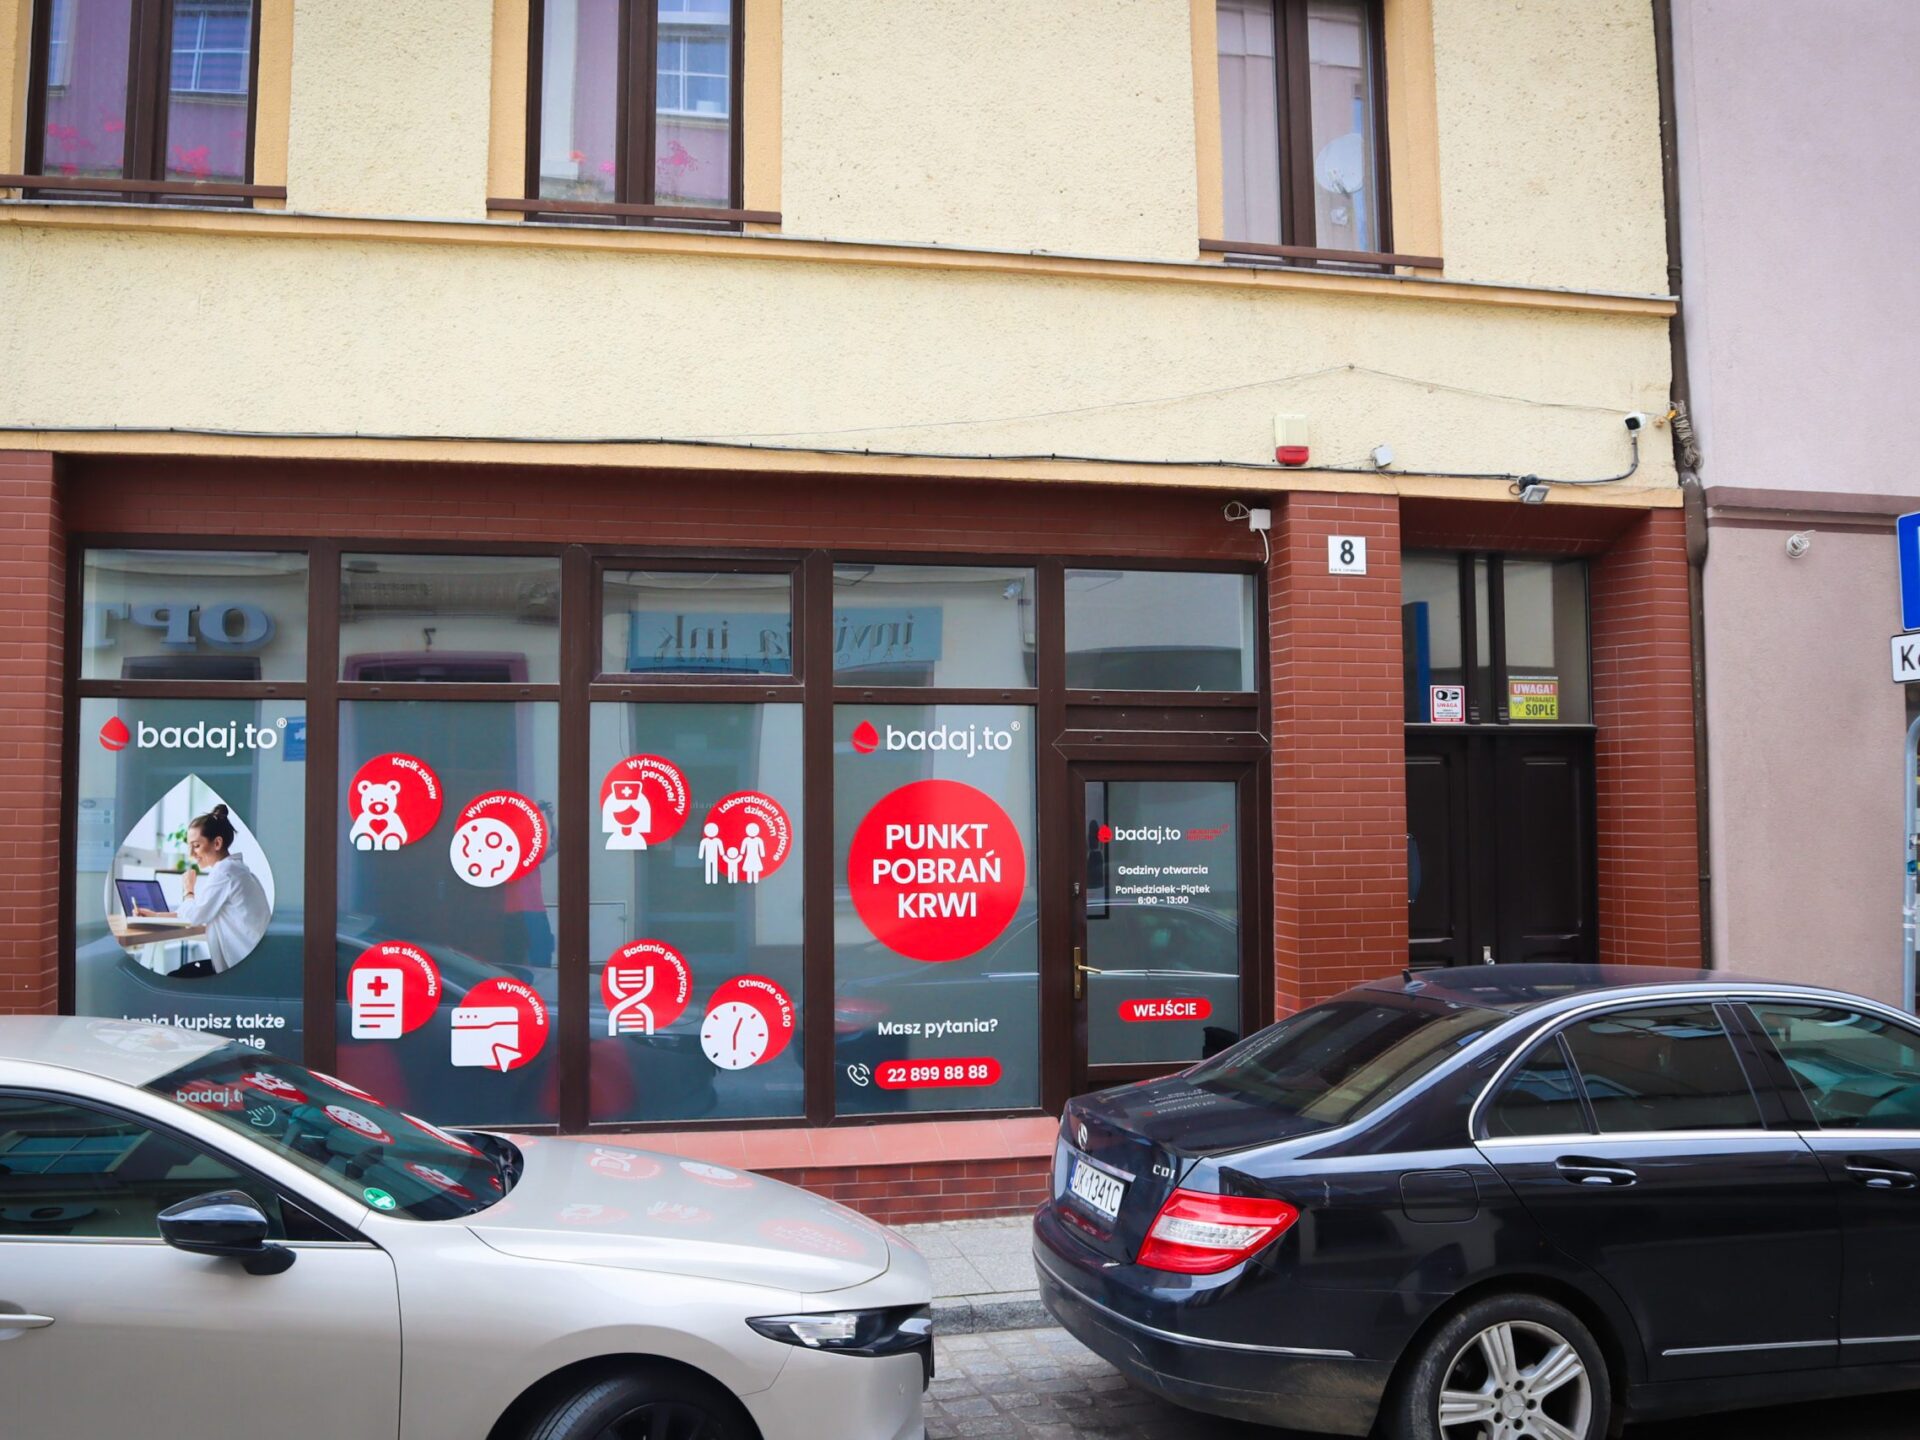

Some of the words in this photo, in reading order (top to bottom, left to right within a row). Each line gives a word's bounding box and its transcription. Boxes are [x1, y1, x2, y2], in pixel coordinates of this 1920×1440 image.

[1340, 539, 1355, 565] 8
[1901, 644, 1920, 671] K
[1513, 683, 1553, 694] UWAGA!
[1525, 703, 1555, 716] SOPLE
[391, 757, 420, 772] Kącik
[418, 769, 437, 800] zabaw
[626, 758, 686, 816] Wykwalifikowany
[642, 770, 676, 802] personel
[466, 795, 507, 818] Wymazy
[507, 796, 543, 868] mikrobiologiczne
[718, 795, 779, 817] Laboratorium
[773, 815, 789, 862] przyjazne
[743, 806, 777, 837] dzieciom
[886, 823, 988, 850] PUNKT
[1115, 826, 1181, 845] badaj.to
[872, 850, 1001, 885] POBRAŃ
[1118, 865, 1161, 877] Godziny
[1162, 864, 1209, 875] otwarcia
[898, 892, 977, 918] KRWI
[1166, 895, 1189, 905] 13:00
[382, 946, 400, 956] Bez
[402, 947, 436, 997] skierowania
[623, 943, 666, 958] Badania
[664, 951, 688, 1004] genetyczne
[497, 981, 531, 999] Wyniki
[528, 995, 544, 1026] online
[738, 979, 777, 995] Otwarte
[774, 992, 787, 1006] od
[174, 1014, 231, 1031] kupisz
[236, 1013, 286, 1029] także
[1133, 1000, 1197, 1017] WEJŚCIE
[878, 1021, 921, 1036] Masz
[925, 1018, 999, 1039] pytania?
[887, 1068, 907, 1083] 22
[910, 1066, 940, 1082] 899
[944, 1065, 964, 1080] 88
[968, 1064, 988, 1079] 88
